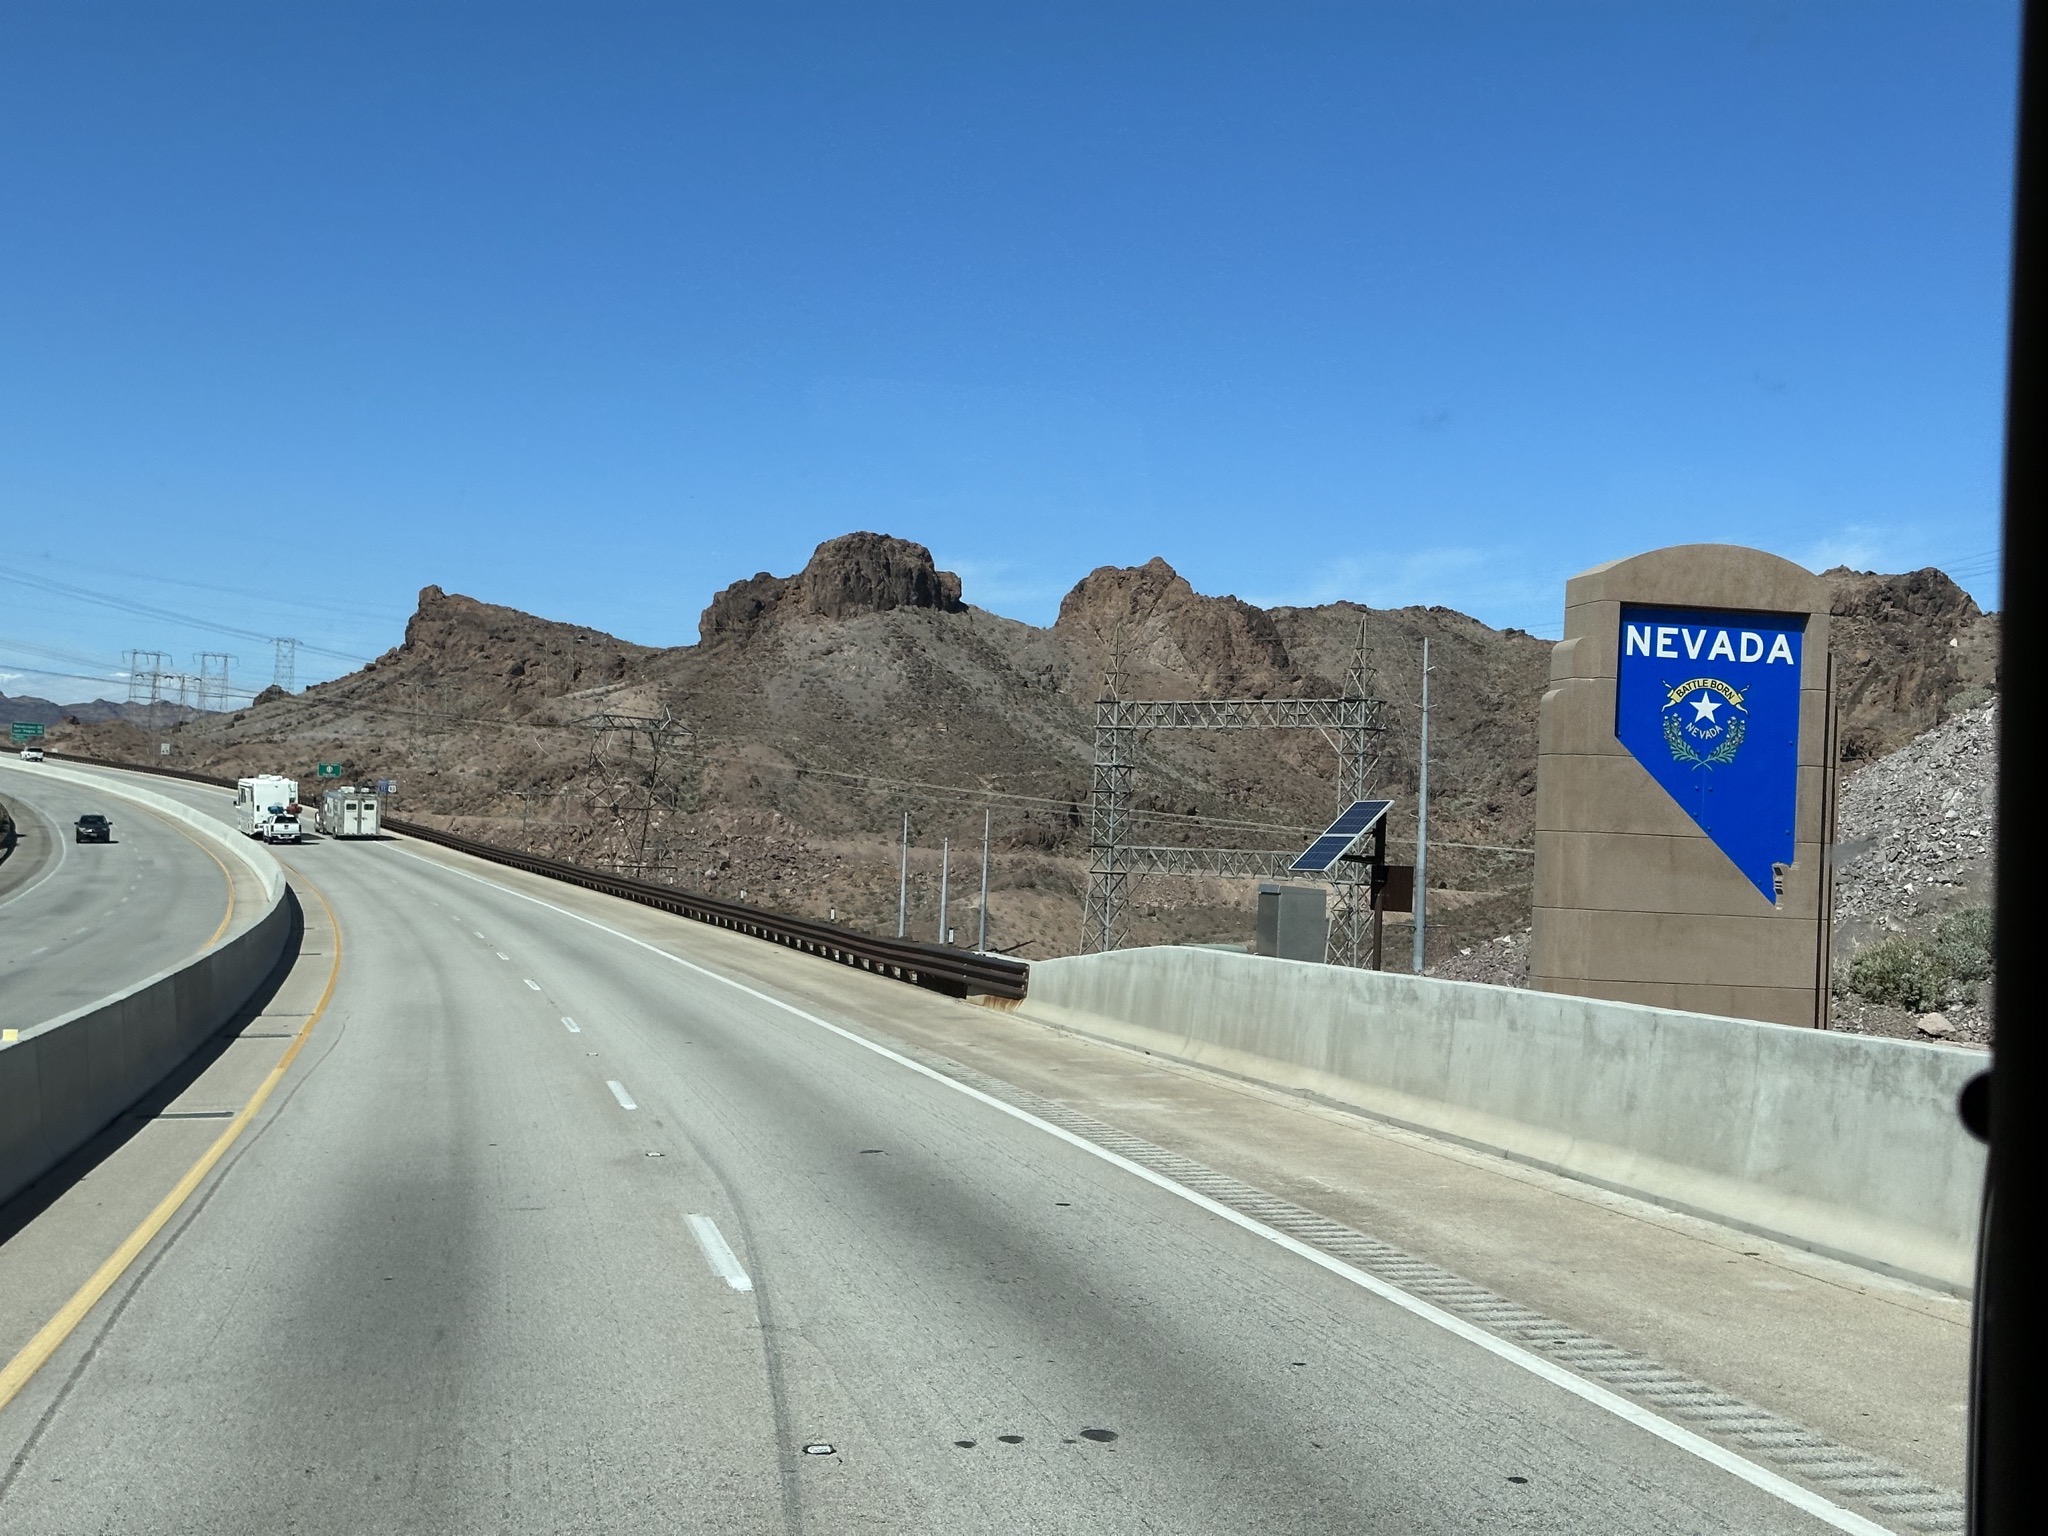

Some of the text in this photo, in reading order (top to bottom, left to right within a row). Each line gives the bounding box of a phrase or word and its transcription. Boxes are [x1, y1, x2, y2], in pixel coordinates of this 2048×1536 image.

[1626, 625, 1794, 665] NEVADA
[1675, 679, 1735, 700] BATTLE BORN
[1685, 722, 1723, 739] NEVADA
